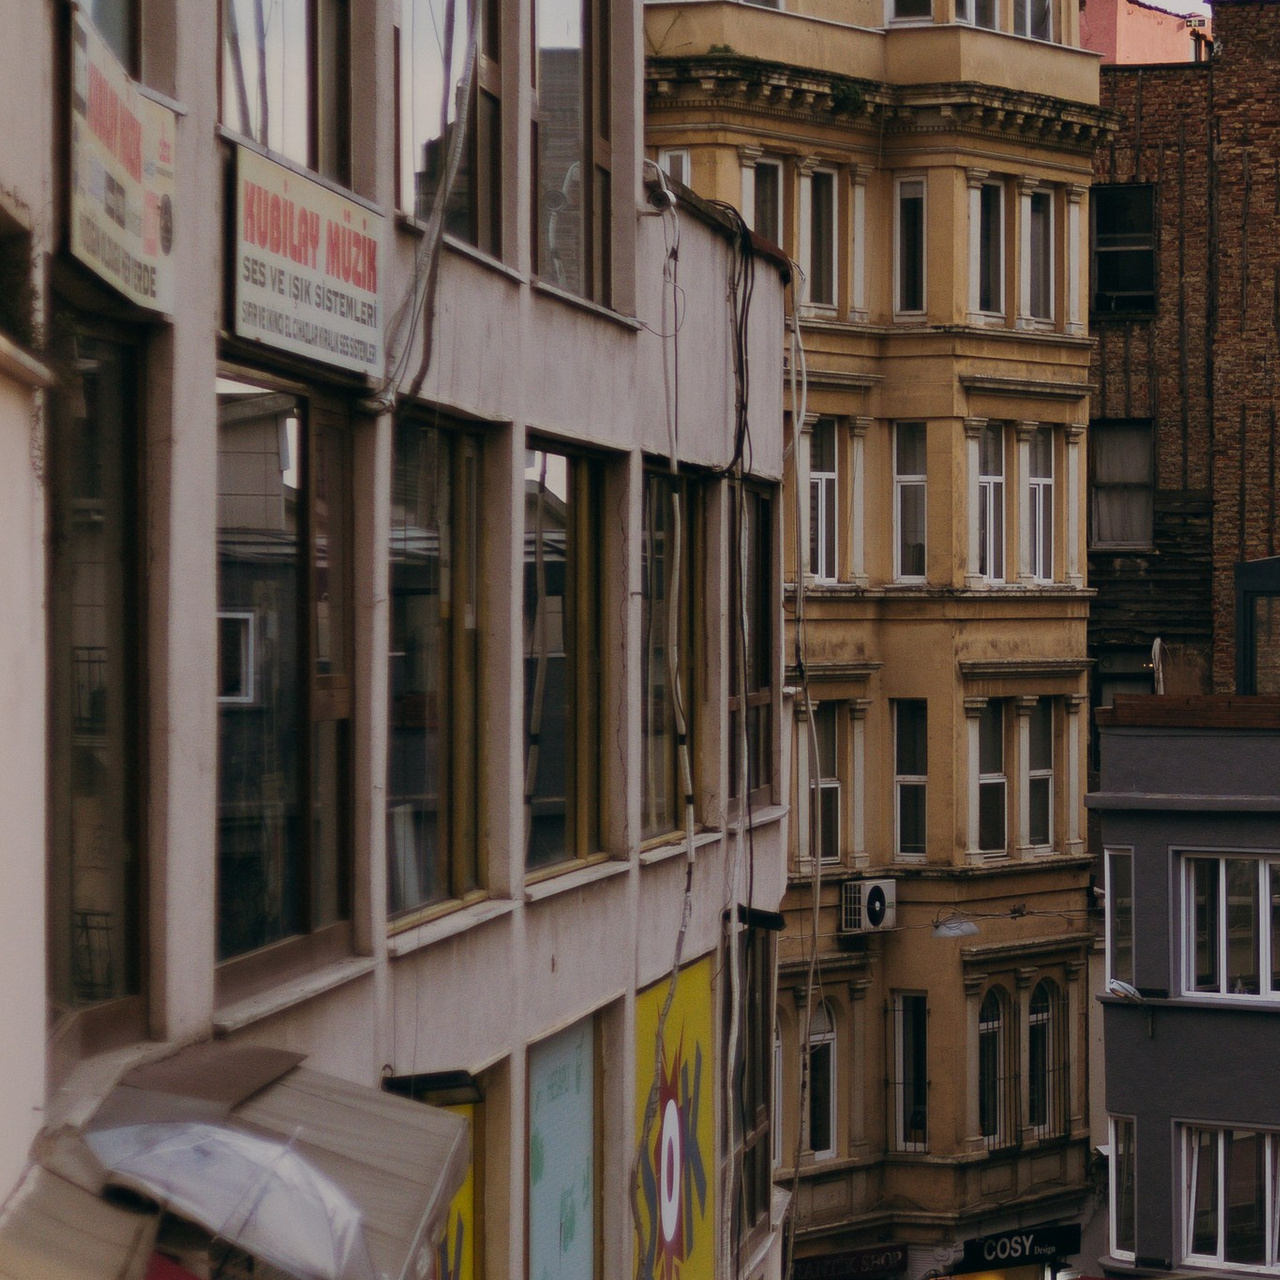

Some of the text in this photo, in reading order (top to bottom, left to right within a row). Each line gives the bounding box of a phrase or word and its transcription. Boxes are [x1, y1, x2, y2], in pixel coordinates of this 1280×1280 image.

[243, 178, 320, 270] KUBİLAY
[326, 208, 377, 294] MÜZİK
[243, 255, 266, 289] SES
[270, 265, 285, 296] VE
[315, 279, 377, 329] SİSTEMLERİ
[861, 1251, 903, 1273] SHOP
[983, 1234, 1056, 1261] COSY Design
